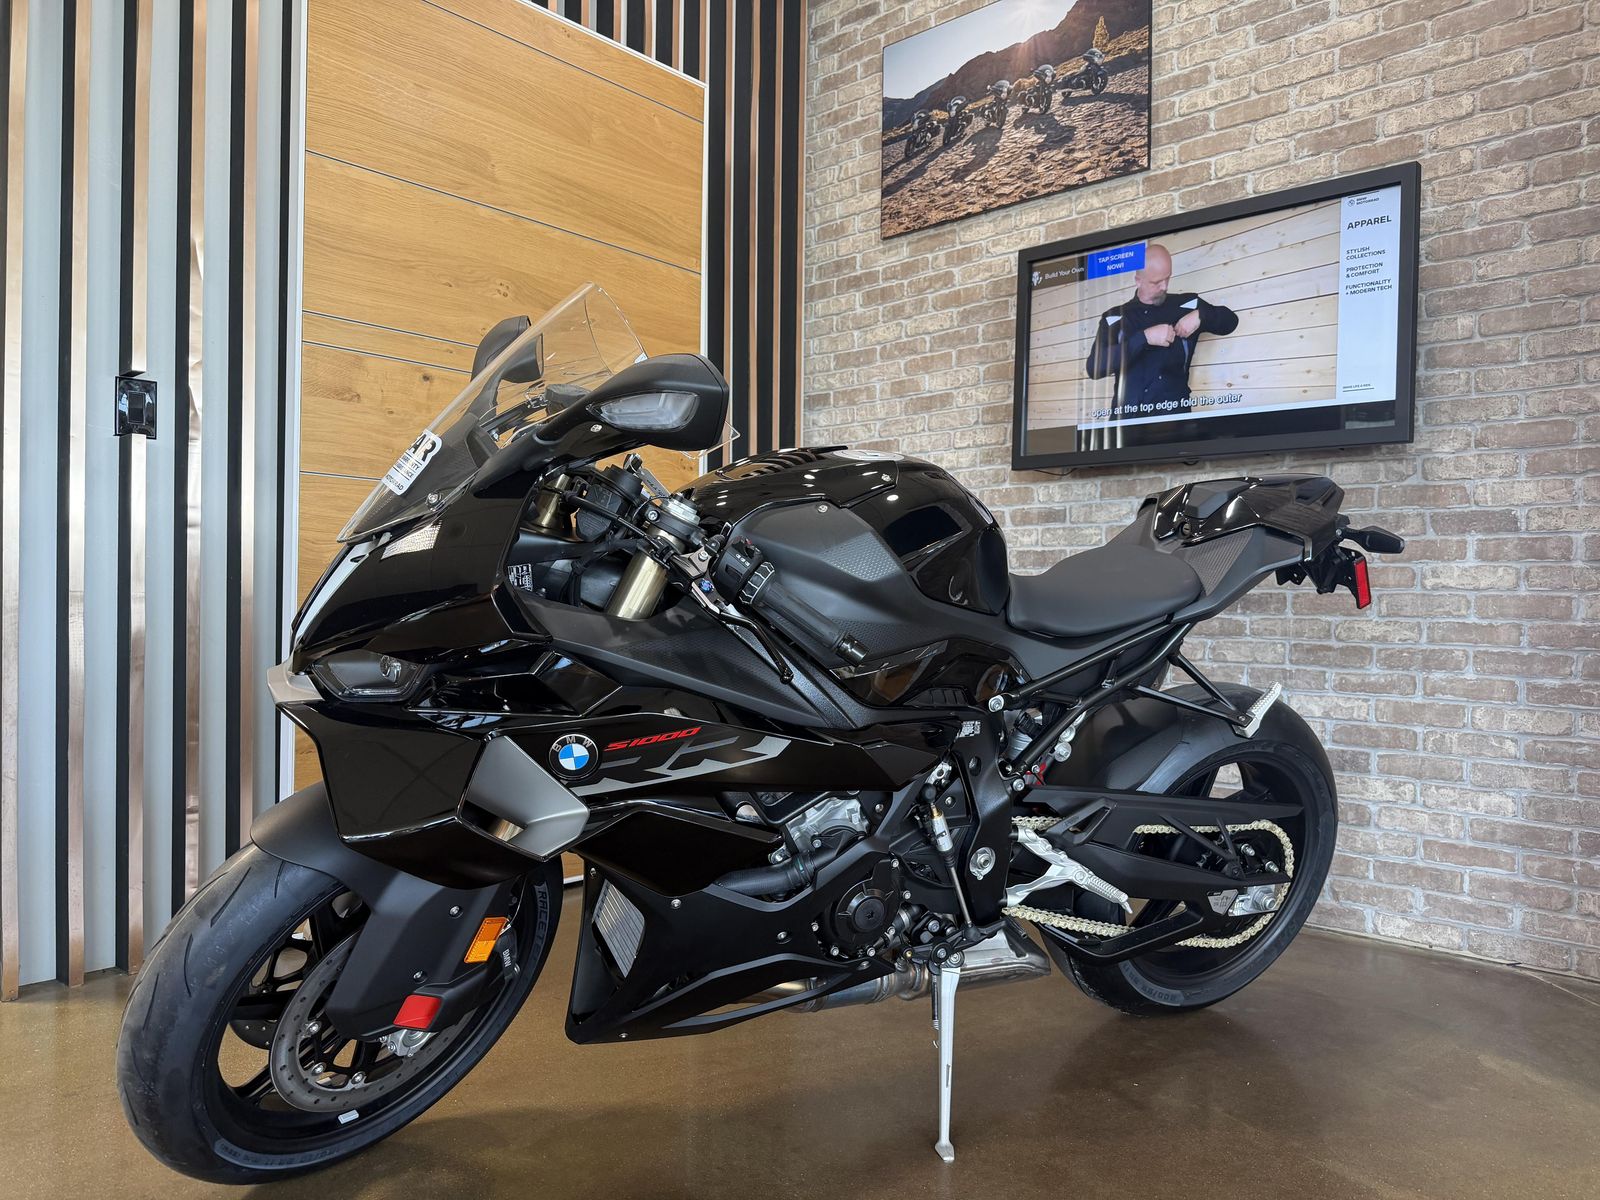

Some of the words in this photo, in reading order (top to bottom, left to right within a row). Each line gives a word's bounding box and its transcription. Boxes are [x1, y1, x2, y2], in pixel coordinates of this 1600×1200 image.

[1347, 215, 1392, 230] APPAREL
[1346, 246, 1370, 254] STYLISH
[1346, 249, 1386, 260] COLLECTIONS
[1098, 255, 1110, 263] TAP
[1110, 251, 1134, 261] SCREEN
[1106, 262, 1125, 271] NOW!
[1346, 262, 1383, 272] PROTECTION
[1044, 272, 1059, 280] Build
[1059, 269, 1070, 277] Your
[1350, 268, 1380, 278] COMFORT
[1345, 279, 1391, 290] FUNCTIONALITY
[1350, 287, 1376, 295] MODERN
[1091, 408, 1112, 419] open
[1114, 406, 1122, 415] at
[1124, 404, 1138, 414] the
[1140, 402, 1154, 413] top
[1156, 400, 1178, 412] edge
[1180, 397, 1198, 408] fold
[1199, 395, 1214, 405] the
[1216, 393, 1243, 403] outer
[552, 735, 593, 753] BMW
[603, 726, 702, 751] S1000
[502, 948, 512, 968] BMW
